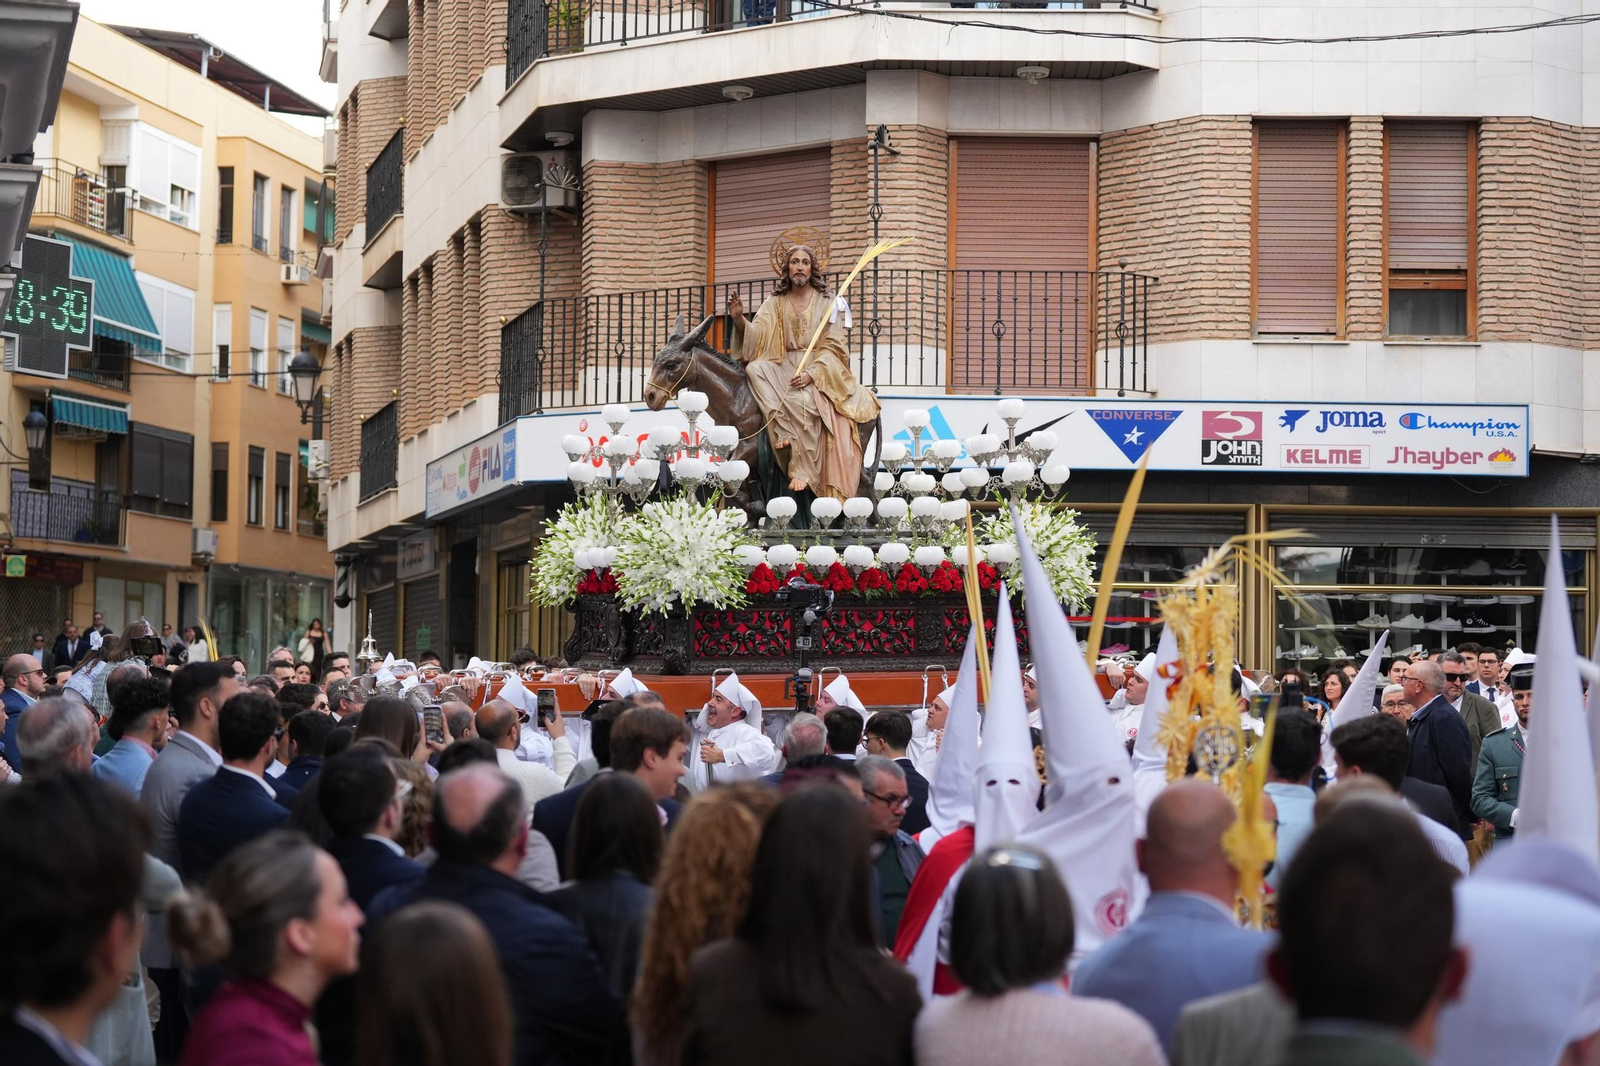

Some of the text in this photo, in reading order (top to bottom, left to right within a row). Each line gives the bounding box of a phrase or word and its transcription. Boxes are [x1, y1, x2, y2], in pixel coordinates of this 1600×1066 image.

[1092, 410, 1173, 420] CONVERSE
[1315, 411, 1386, 433] Joma
[1399, 412, 1521, 436] Champion
[1486, 430, 1518, 438] U.S.A.
[1203, 440, 1261, 463] JOHN
[1229, 455, 1260, 465] SMITH
[1286, 449, 1362, 465] KELME
[482, 443, 501, 484] FILA
